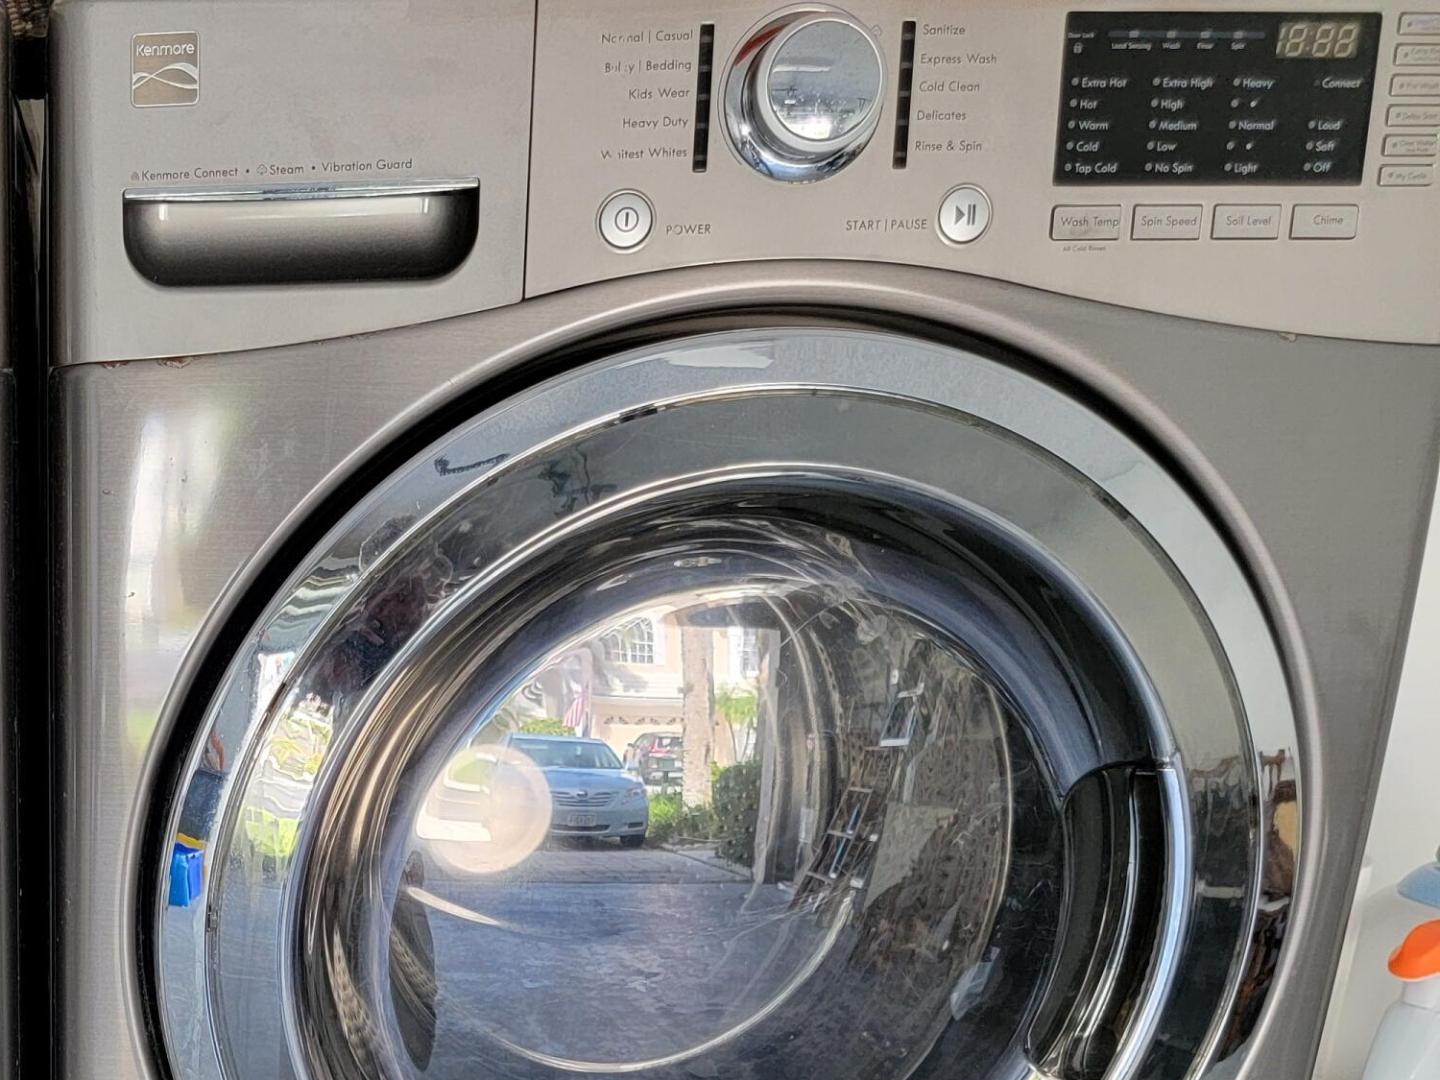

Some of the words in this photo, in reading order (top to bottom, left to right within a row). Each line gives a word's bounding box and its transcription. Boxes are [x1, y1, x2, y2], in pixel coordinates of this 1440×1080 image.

[655, 29, 693, 42] Casual
[922, 23, 966, 36] Sanitize
[135, 42, 195, 57] Kenmore
[919, 53, 962, 66] Express
[966, 53, 998, 65] Wash
[646, 60, 692, 73] Bedding
[919, 81, 945, 92] Cold
[949, 81, 981, 92] Clean
[1081, 77, 1106, 89] Extra
[1109, 78, 1128, 89] Hot
[1162, 77, 1187, 89] Extra
[1190, 78, 1213, 91] High
[1242, 79, 1274, 90] Heavy
[1321, 78, 1361, 89] Connect
[628, 89, 653, 100] Kids
[657, 88, 690, 99] Wear
[1079, 99, 1098, 110] Hot
[1160, 99, 1184, 111] High
[916, 110, 967, 121] Delicates
[622, 117, 659, 130] Heavy
[662, 116, 689, 129] Duty
[1078, 121, 1109, 131] Warm
[1158, 120, 1197, 131] Medium
[1238, 120, 1275, 131] Normal
[1317, 120, 1342, 131] Loud
[914, 140, 943, 151] Rinse
[945, 140, 955, 151] &
[958, 140, 982, 153] Spin
[1076, 141, 1100, 152] Cold
[1156, 141, 1177, 152] Low
[1315, 141, 1335, 152] Soft
[648, 148, 687, 159] Whites
[141, 170, 191, 181] Kenmore
[194, 167, 239, 179] Connect
[269, 164, 305, 176] Steam
[321, 160, 372, 173] Vibration
[376, 158, 413, 171] Guard
[1075, 163, 1092, 175] Tap
[1094, 163, 1118, 174] Cold
[1154, 163, 1170, 174] No
[1171, 163, 1194, 175] Spin
[1234, 163, 1258, 175] Light
[1312, 162, 1331, 174] Off
[845, 219, 881, 232] START
[890, 218, 928, 231] PAUSE
[1060, 216, 1089, 228] Wash
[1093, 216, 1120, 230] Temp
[1141, 216, 1162, 228] Spin
[1165, 216, 1197, 228] Speed
[1225, 215, 1245, 226] Soil
[1246, 215, 1272, 226] Level
[1313, 214, 1344, 226] Chime
[666, 223, 711, 236] POWER
